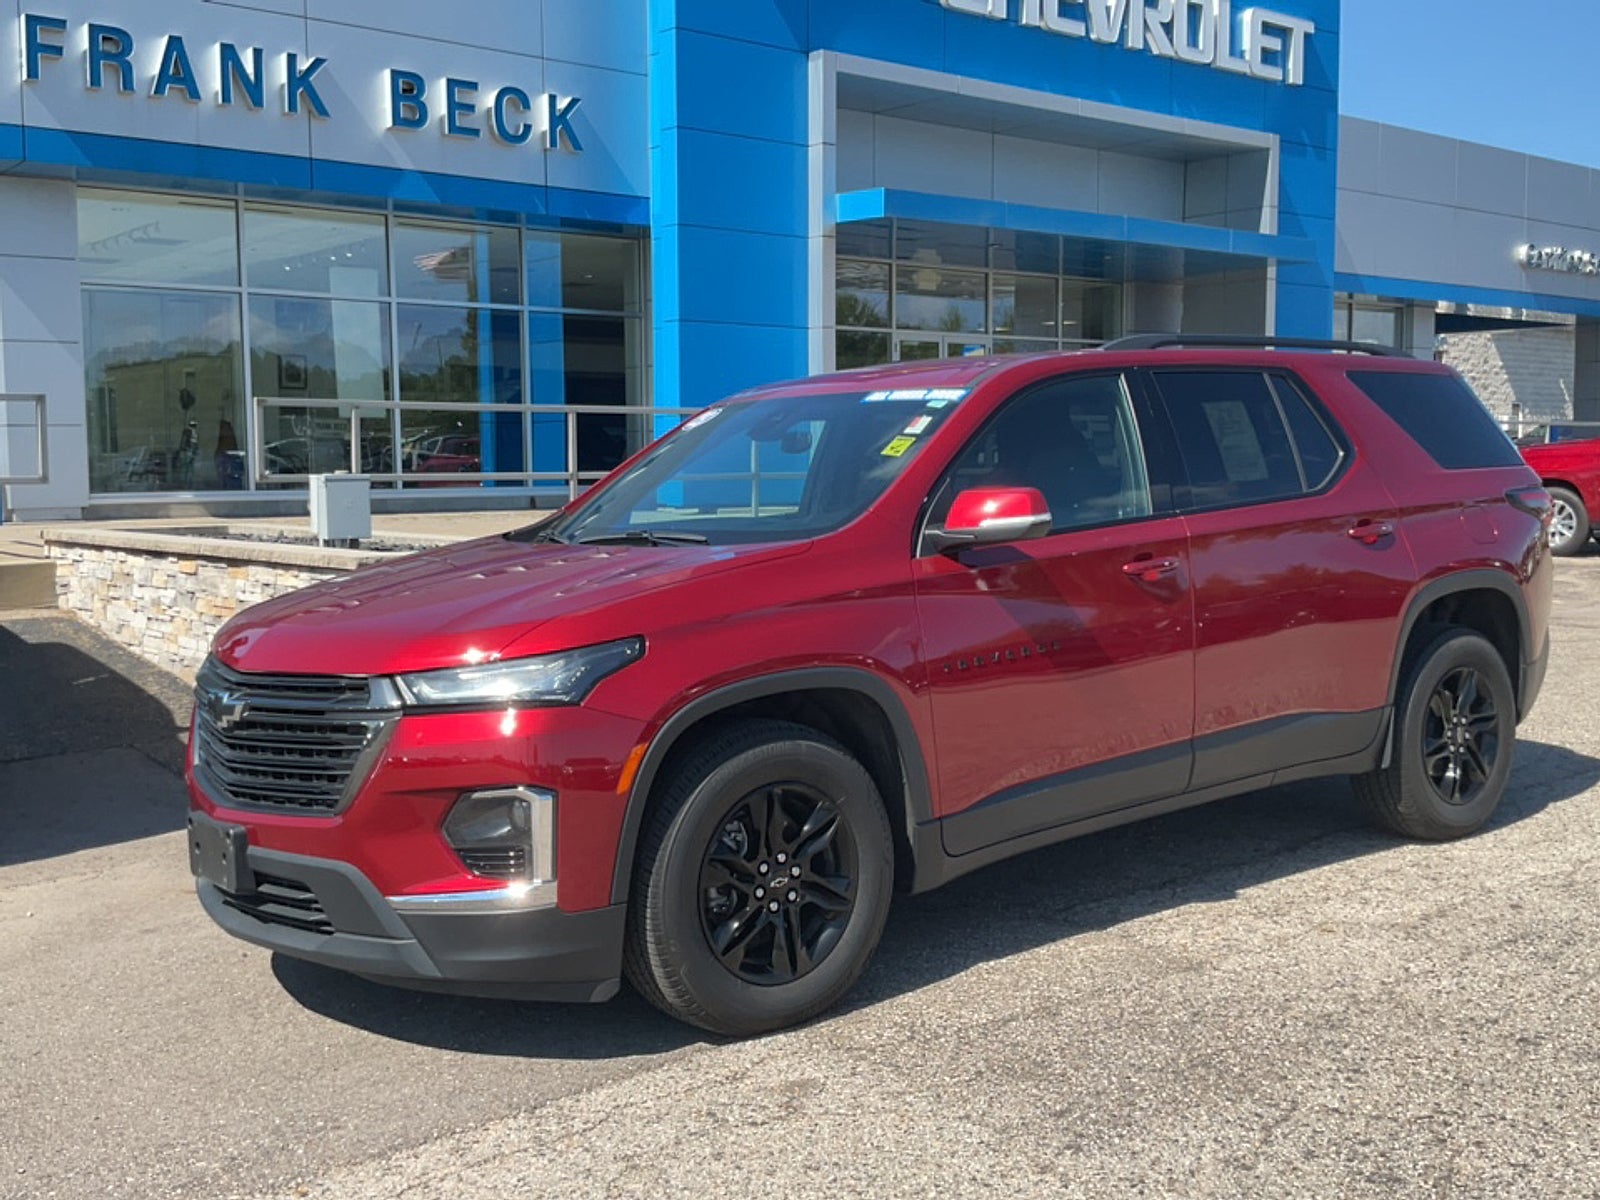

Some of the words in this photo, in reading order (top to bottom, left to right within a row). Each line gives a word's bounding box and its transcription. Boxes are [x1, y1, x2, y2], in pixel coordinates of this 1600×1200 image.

[20, 12, 332, 119] FRANK
[385, 67, 586, 154] BECK
[940, 0, 1315, 85] EVROLET
